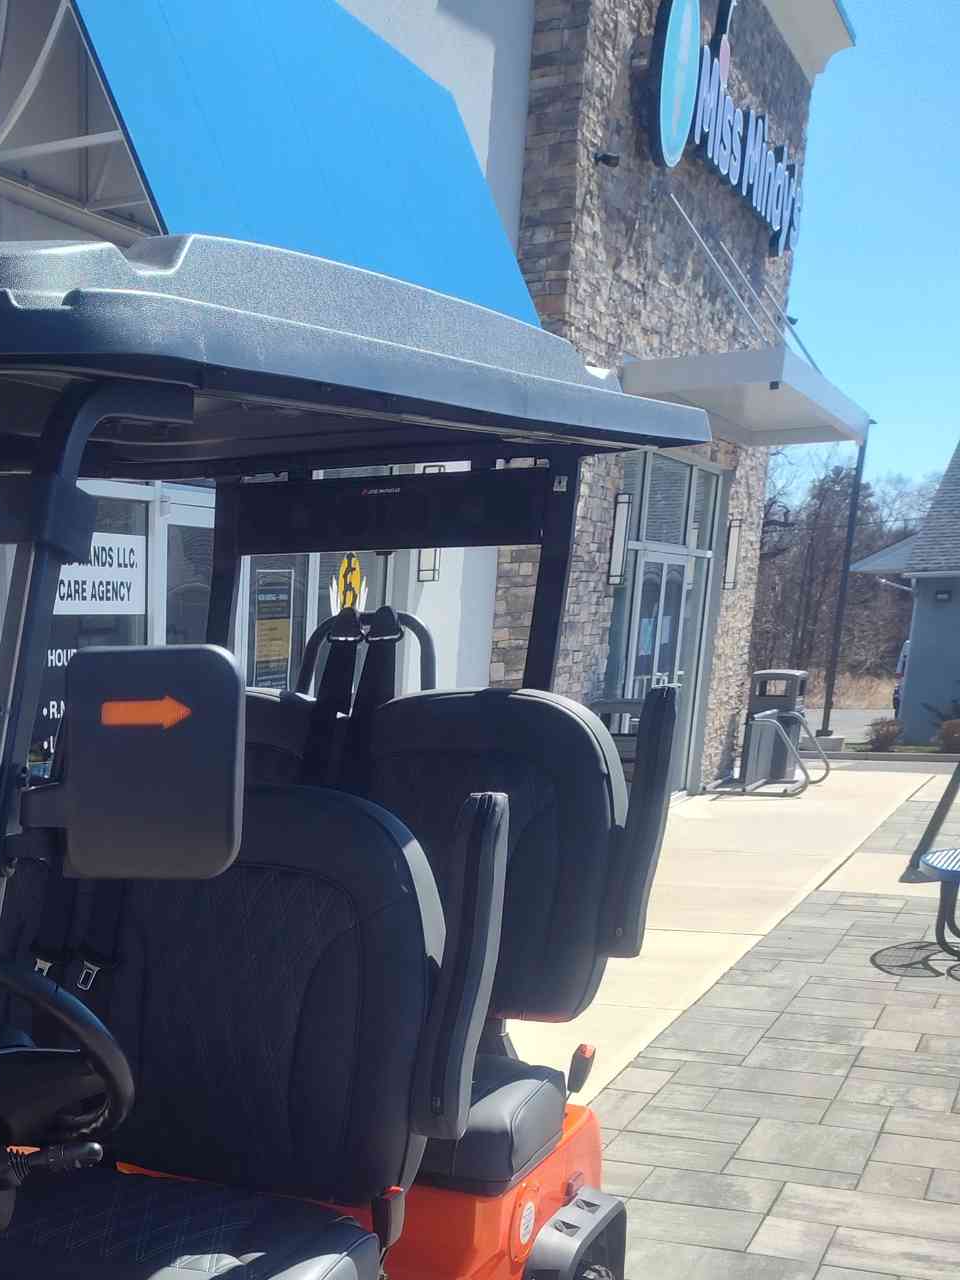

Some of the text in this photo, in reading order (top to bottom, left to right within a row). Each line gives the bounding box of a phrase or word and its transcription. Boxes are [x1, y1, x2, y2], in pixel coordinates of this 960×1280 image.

[694, 44, 743, 186] Miss
[58, 579, 132, 601] CARE AGENCY
